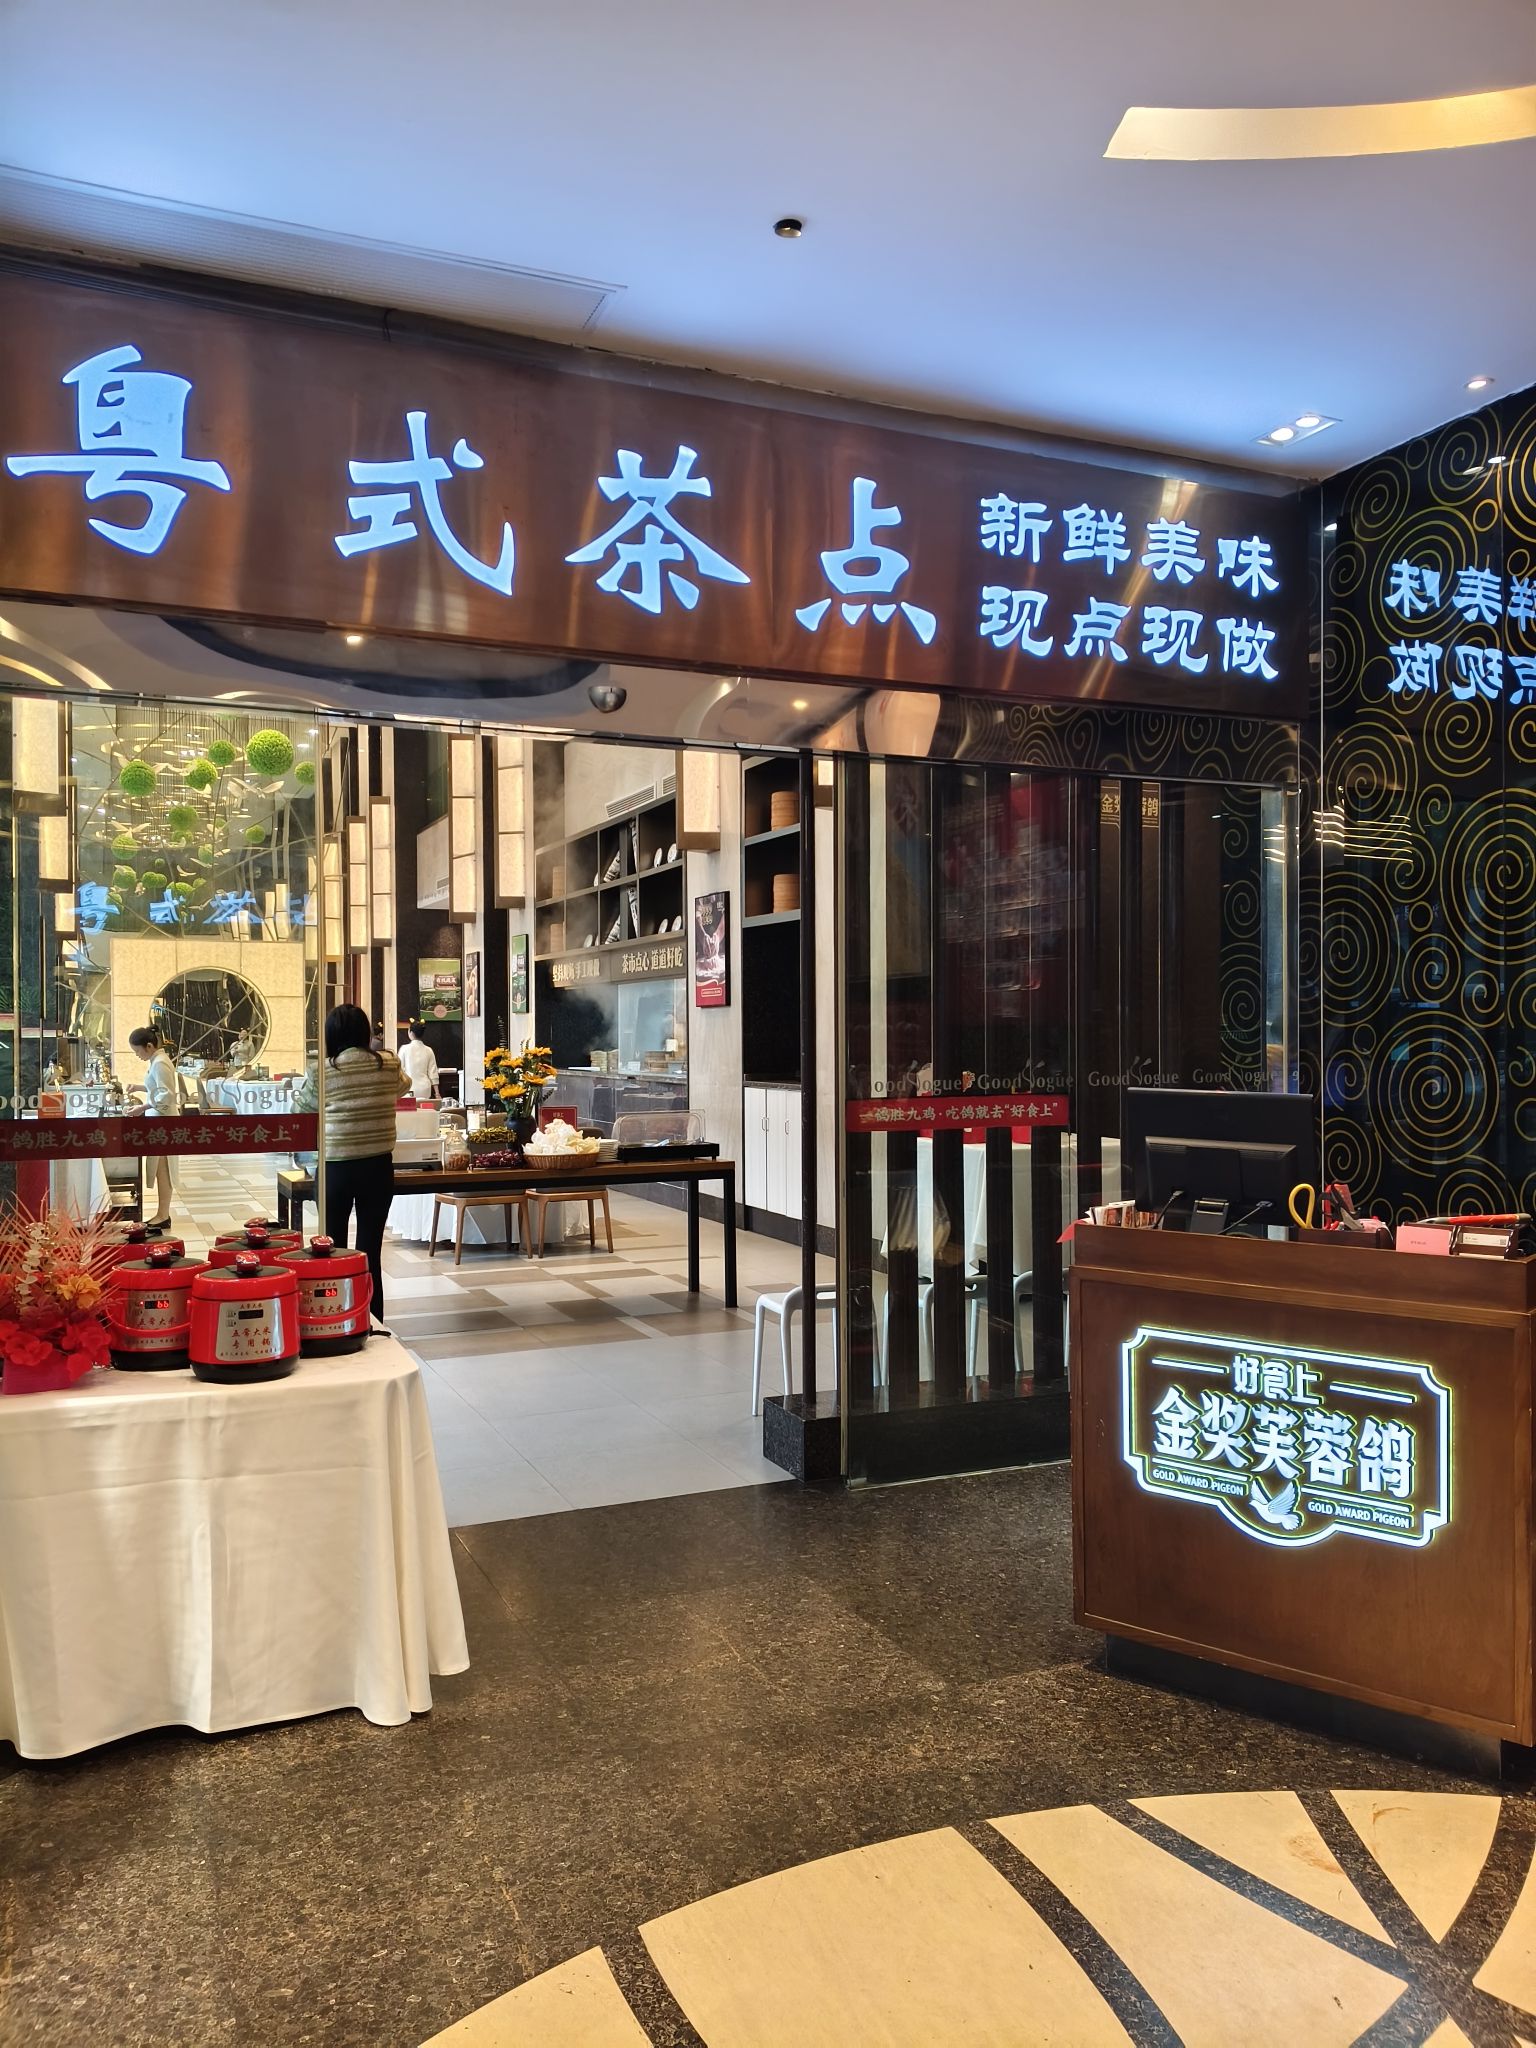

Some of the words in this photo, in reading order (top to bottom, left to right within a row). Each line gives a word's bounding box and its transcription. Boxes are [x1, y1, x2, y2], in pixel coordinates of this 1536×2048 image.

[6, 344, 937, 646] 粤式茶点
[979, 493, 1280, 597] 新鲜美味
[979, 585, 1280, 681] 现点现做
[622, 952, 650, 974] 茶市点心
[651, 946, 684, 970] 道道好吃
[977, 1073, 1022, 1090] Good
[1088, 1071, 1130, 1087] Good
[1192, 1068, 1232, 1084] Good
[0, 1087, 42, 1110] ood
[0, 1123, 300, 1149] 鸽胜九鸡·吃鸽就去“好食上”
[231, 1326, 272, 1338] 五常大米
[1233, 1353, 1321, 1405] 好食上
[1152, 1386, 1413, 1498] 金奖芙蓉鸽
[1152, 1468, 1175, 1482] GOLD
[1177, 1474, 1209, 1489] AWARD
[1211, 1480, 1244, 1496] PIGEON
[1307, 1501, 1333, 1515] GOLD
[1335, 1506, 1371, 1521] AWARD
[1372, 1511, 1410, 1529] PIGEON
